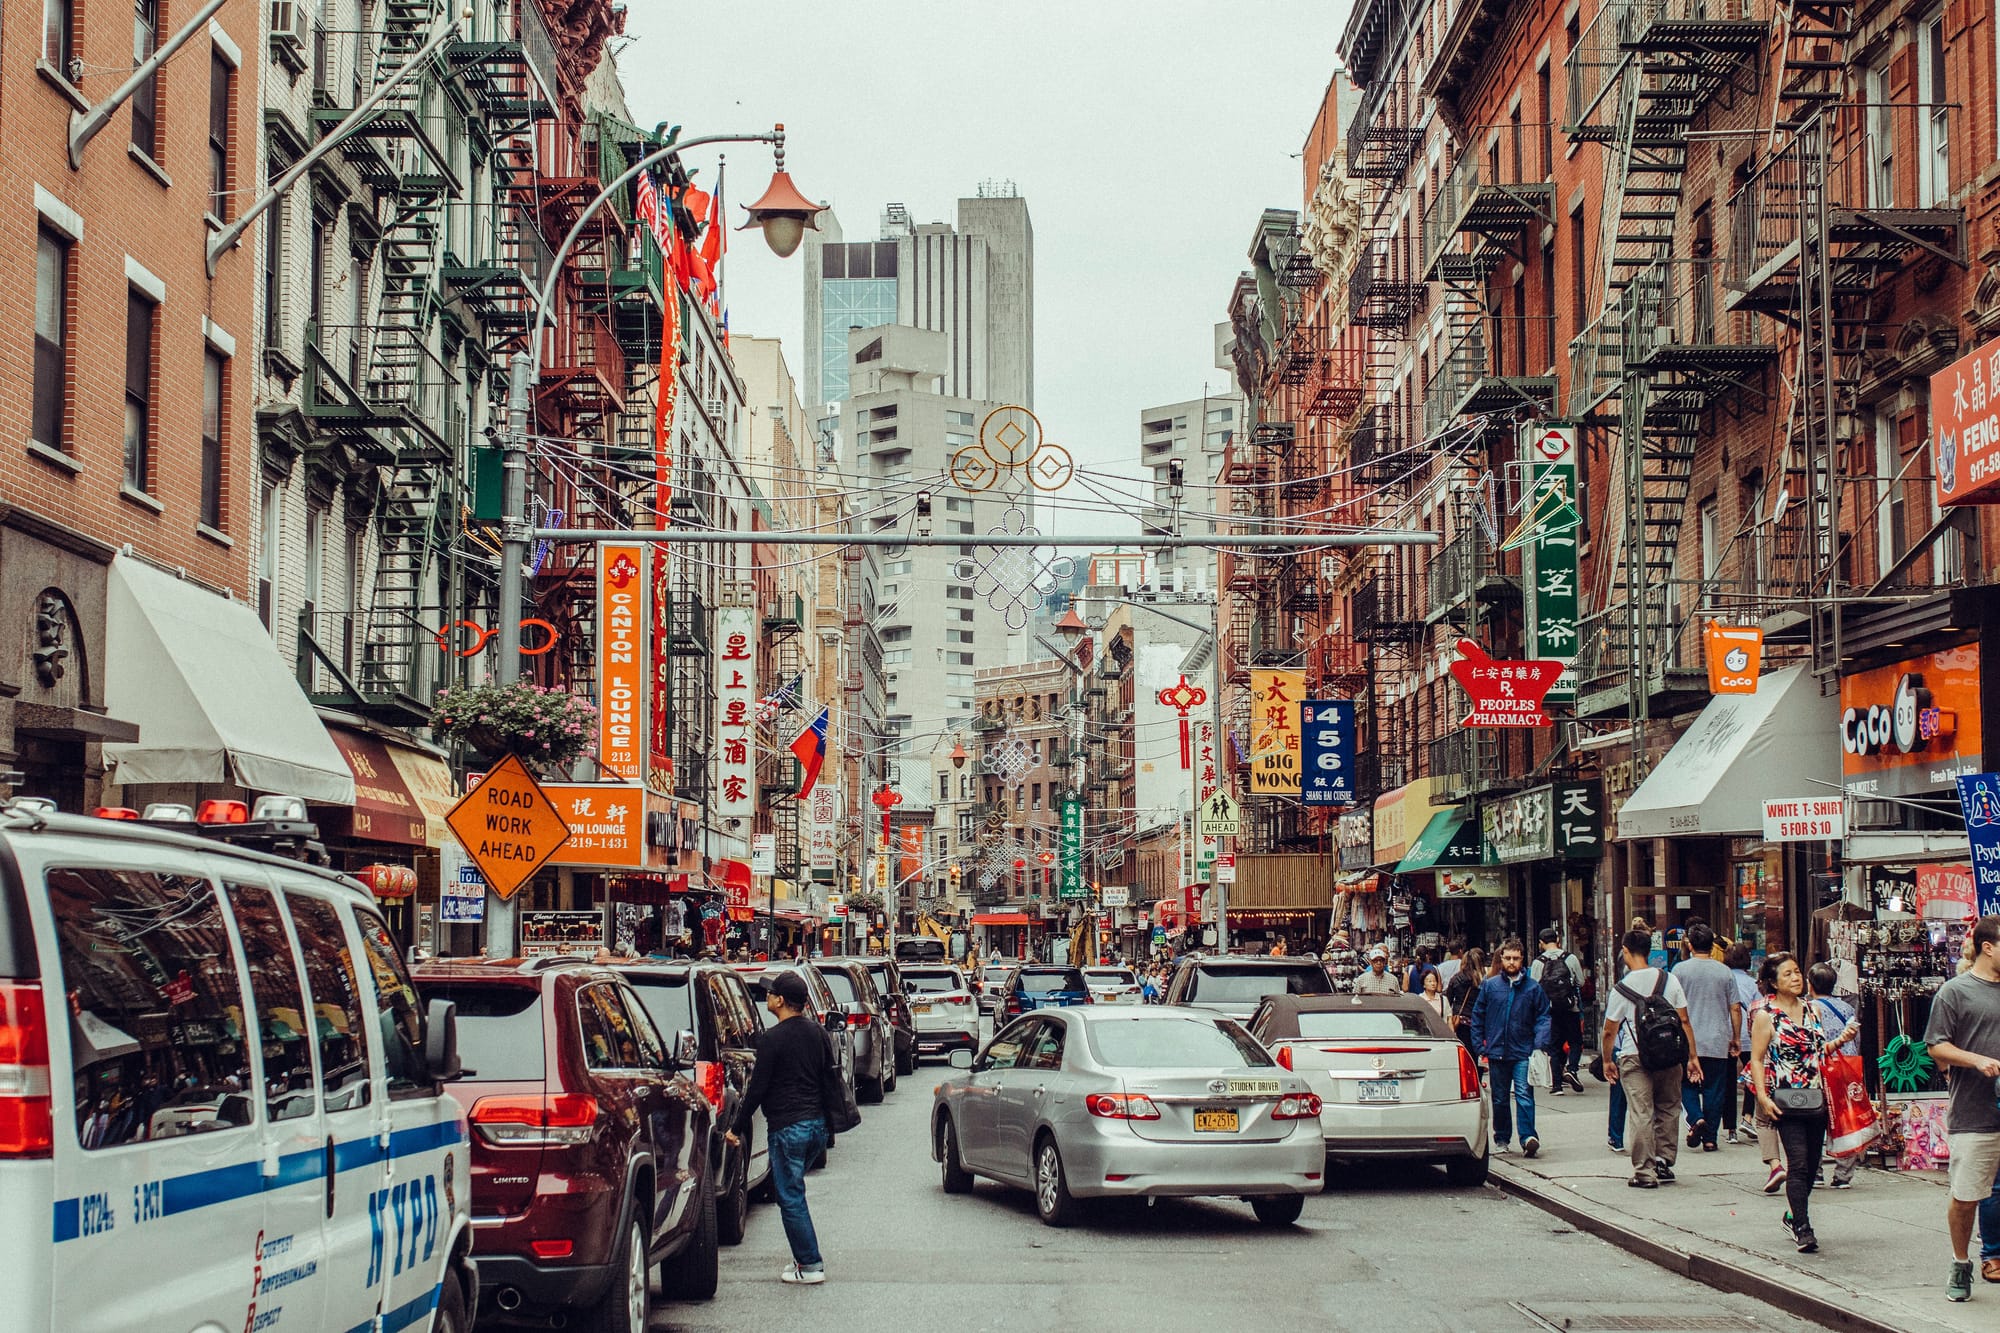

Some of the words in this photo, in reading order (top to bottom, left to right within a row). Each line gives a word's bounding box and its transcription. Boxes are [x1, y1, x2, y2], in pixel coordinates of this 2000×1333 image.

[1963, 414, 2000, 457] FENG
[611, 593, 632, 663] CANTON
[1471, 666, 1542, 681] 仁安西藥房
[1552, 680, 1577, 689] SENG
[1720, 676, 1752, 687] CoCo
[1267, 676, 1290, 730] 大旺
[1480, 699, 1535, 711] PEOPLES
[609, 677, 632, 747] LOUNGE
[722, 632, 751, 803] 皇上皇酒家
[1473, 713, 1542, 725] PHARMACY
[1842, 704, 1892, 756] CoCo
[611, 752, 631, 762] 212
[1265, 754, 1293, 769] BIG
[1256, 772, 1302, 788] WONG
[1930, 769, 1946, 783] Fresh
[488, 787, 533, 809] ROAD
[551, 798, 629, 823] 悅軒
[1560, 788, 1597, 846] 天仁
[1767, 803, 1799, 818] WHITE
[486, 813, 533, 836] WORK
[587, 824, 626, 835] LOUNGE
[1205, 823, 1236, 832] AHEAD
[1781, 823, 1788, 836] 5
[1790, 822, 1809, 836] FOR
[478, 840, 536, 862] AHEAD
[1230, 1081, 1256, 1092] STUDENT
[1257, 1081, 1279, 1092] DRIVER
[493, 1176, 529, 1184] LIMITED
[143, 1180, 160, 1222] PCT
[366, 1174, 438, 1289] NYPD
